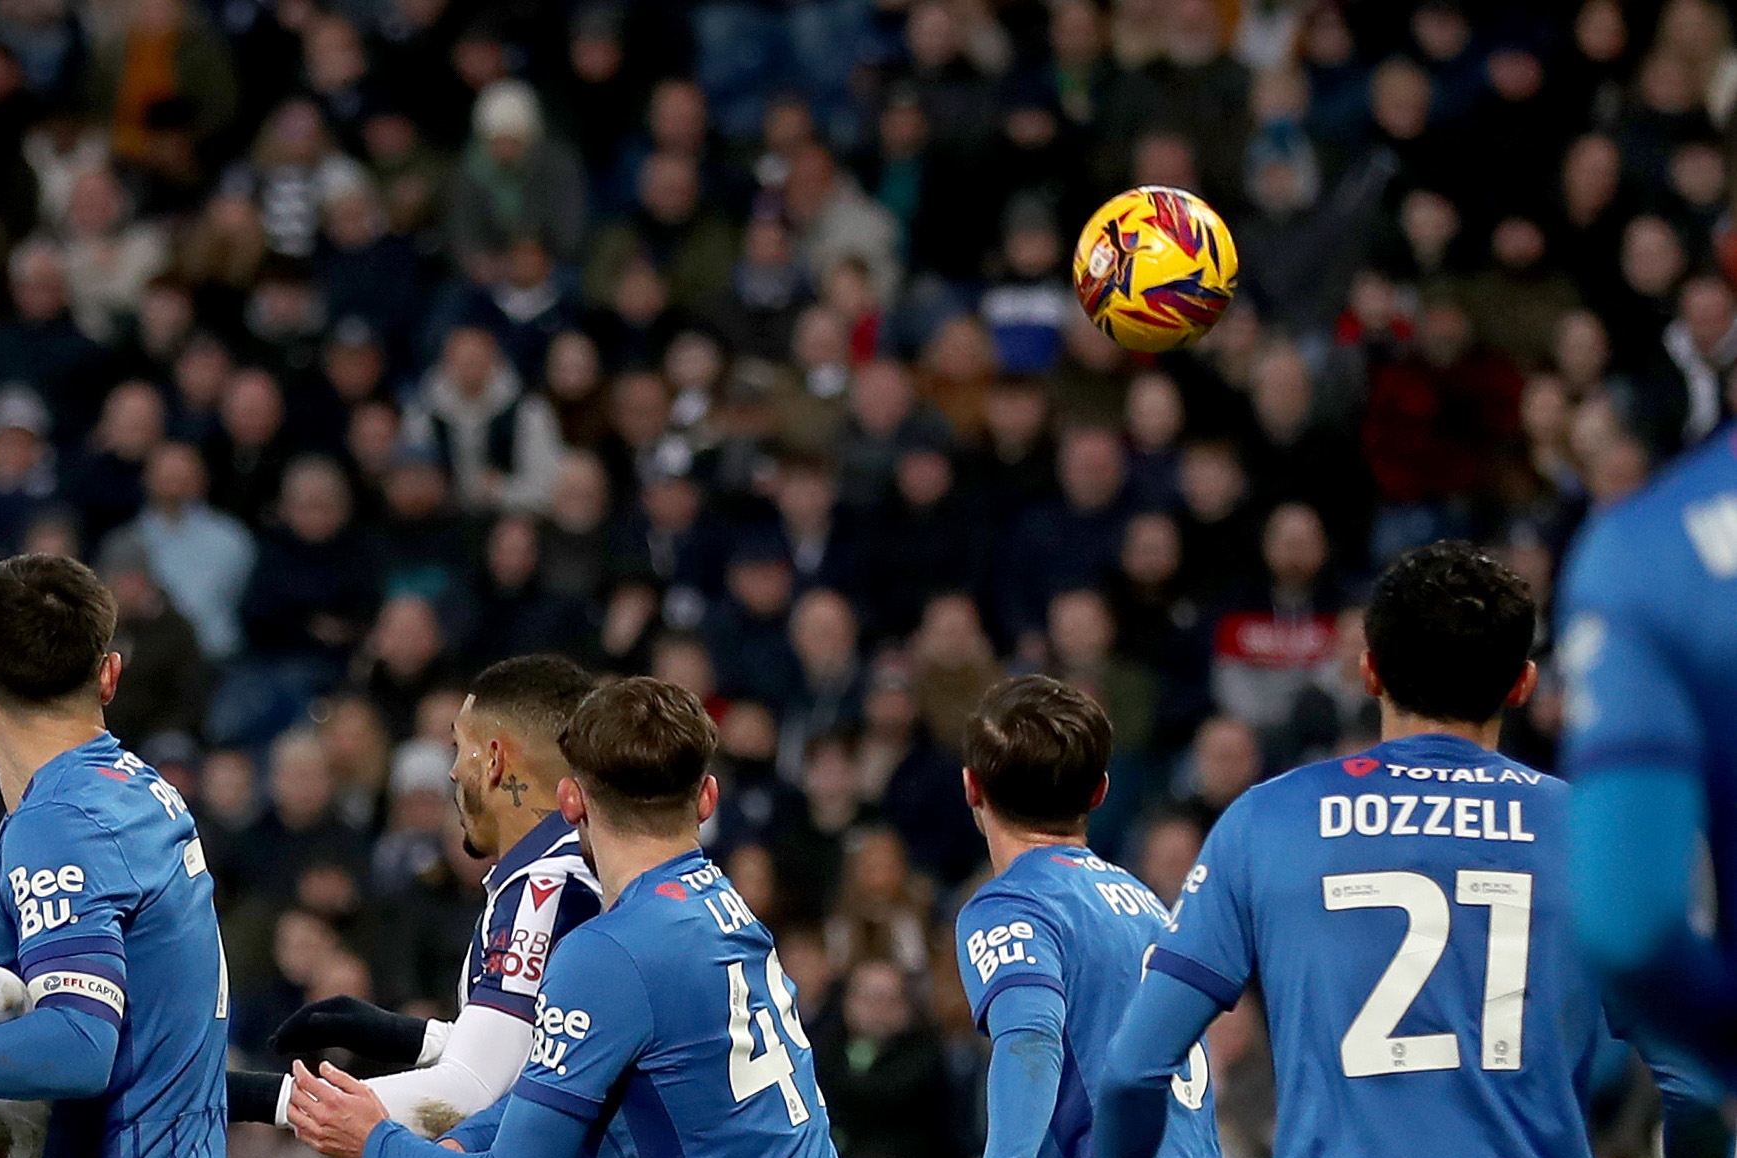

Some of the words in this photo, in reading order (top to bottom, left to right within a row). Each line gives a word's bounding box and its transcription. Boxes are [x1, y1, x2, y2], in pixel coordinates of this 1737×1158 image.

[1386, 763, 1495, 783] TOTAL
[1319, 794, 1536, 843] DOZZELL
[8, 865, 85, 906] Bee
[18, 897, 79, 940] Bu.
[966, 920, 1034, 966] Bee
[976, 941, 1038, 985] Bu.
[63, 977, 85, 989] EFL
[1322, 870, 1532, 1078] 21
